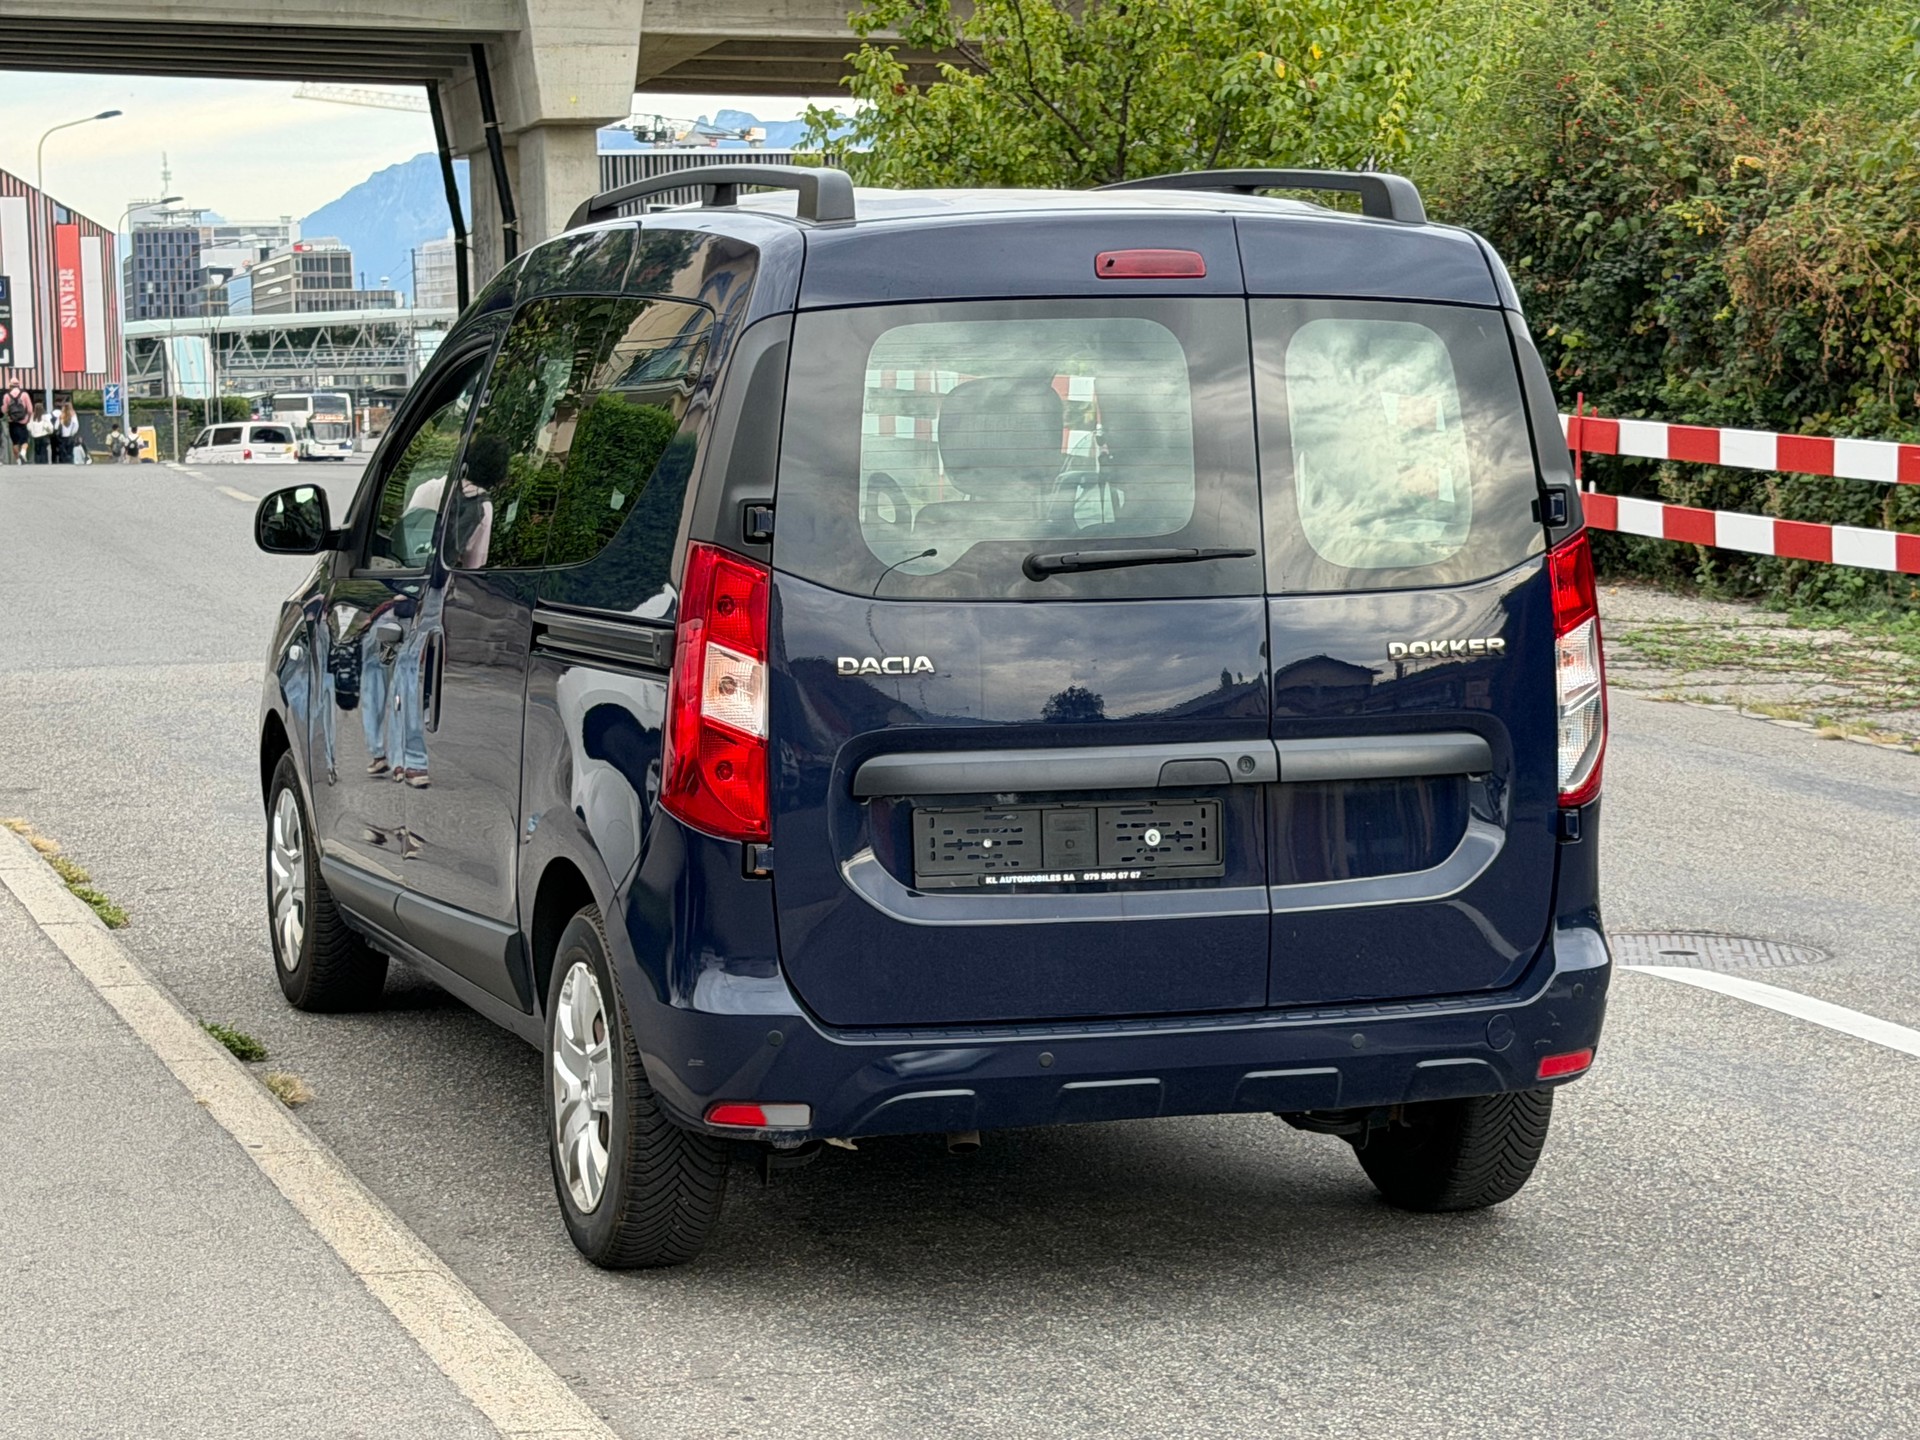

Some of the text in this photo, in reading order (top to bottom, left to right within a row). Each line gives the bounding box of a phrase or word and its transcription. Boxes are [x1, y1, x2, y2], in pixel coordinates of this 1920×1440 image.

[59, 268, 78, 328] SILVER
[1387, 637, 1506, 660] DOKKER
[837, 655, 936, 675] DACIA
[985, 876, 998, 884] KL
[999, 874, 1062, 883] AUTOMOBILES
[1062, 873, 1076, 881] SA
[1083, 872, 1100, 880] 079
